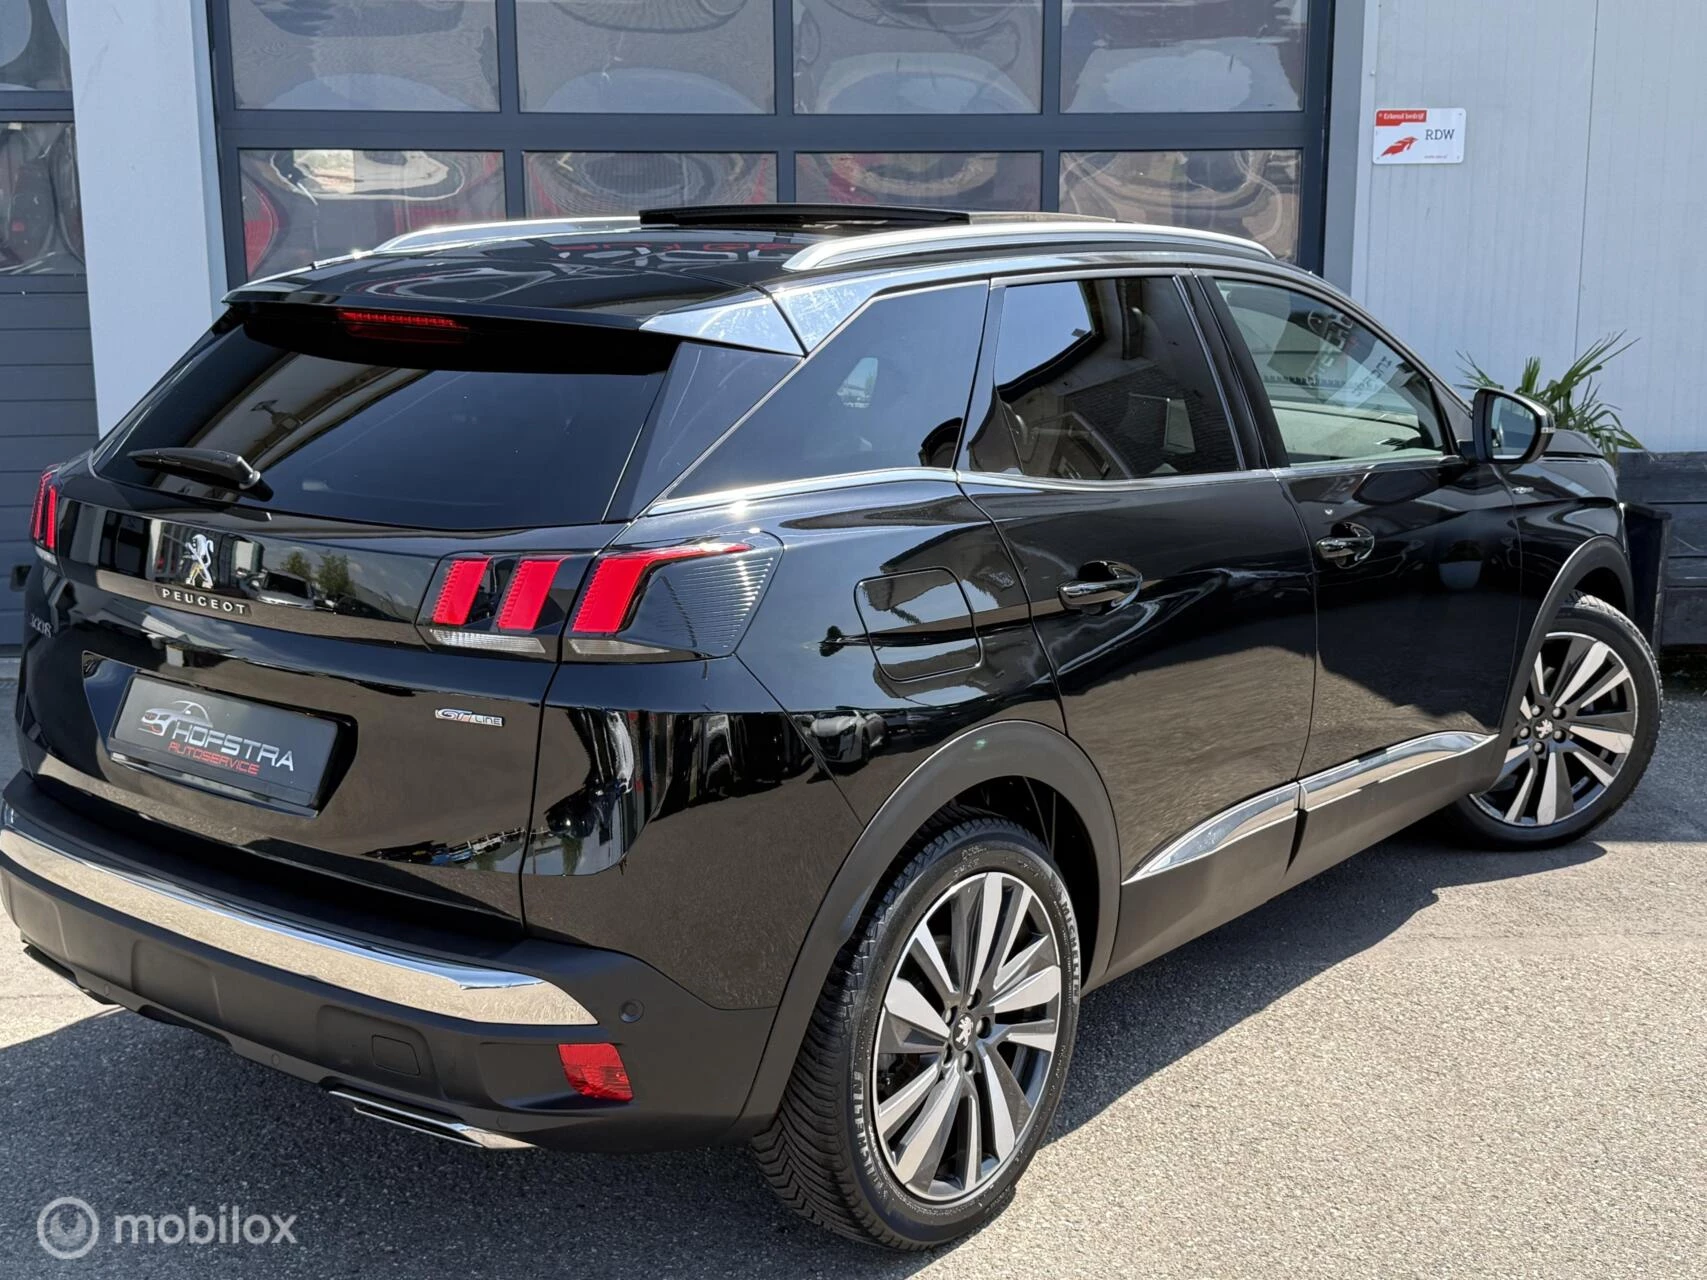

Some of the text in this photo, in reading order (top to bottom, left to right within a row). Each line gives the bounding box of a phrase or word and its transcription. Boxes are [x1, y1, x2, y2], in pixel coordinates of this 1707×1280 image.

[1425, 129, 1455, 140] RDW
[162, 588, 245, 614] PEUGEOT
[168, 740, 261, 775] AUTOSERVICE
[172, 720, 294, 771] HOFSTRA
[1060, 901, 1080, 997] MICHELIN
